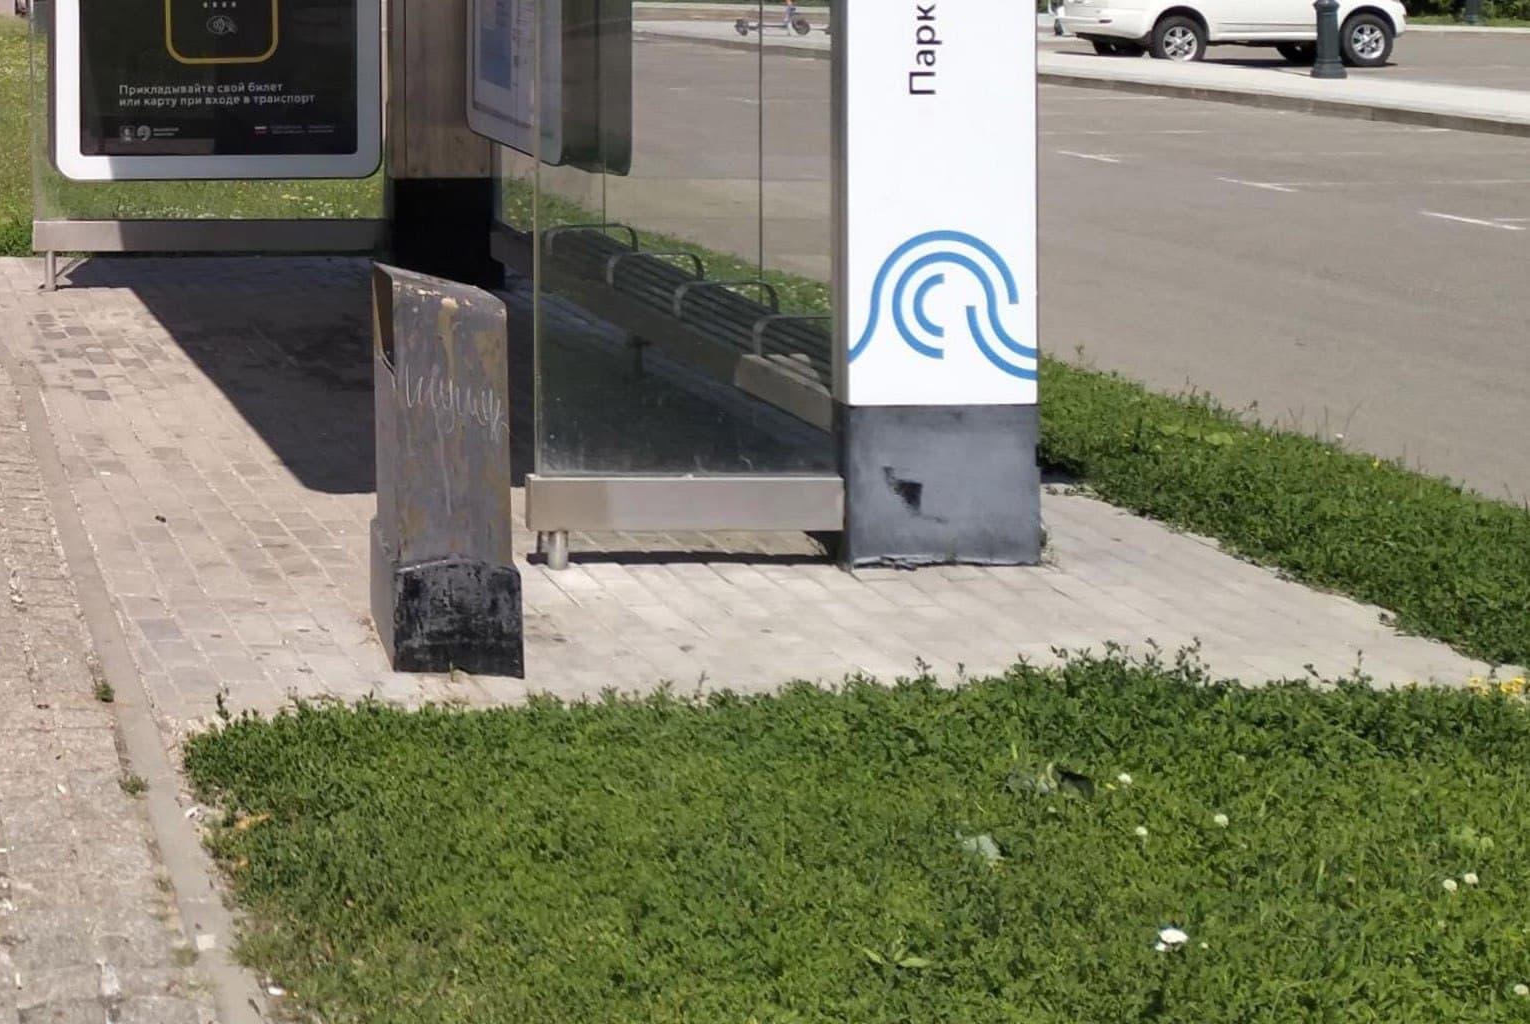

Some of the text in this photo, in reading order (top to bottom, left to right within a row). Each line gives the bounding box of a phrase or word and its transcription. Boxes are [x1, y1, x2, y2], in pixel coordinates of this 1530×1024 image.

[908, 3, 943, 96] Парк
[118, 81, 284, 97] Прикладывайте свой билет
[118, 94, 316, 109] или карту при входе в транспорт
